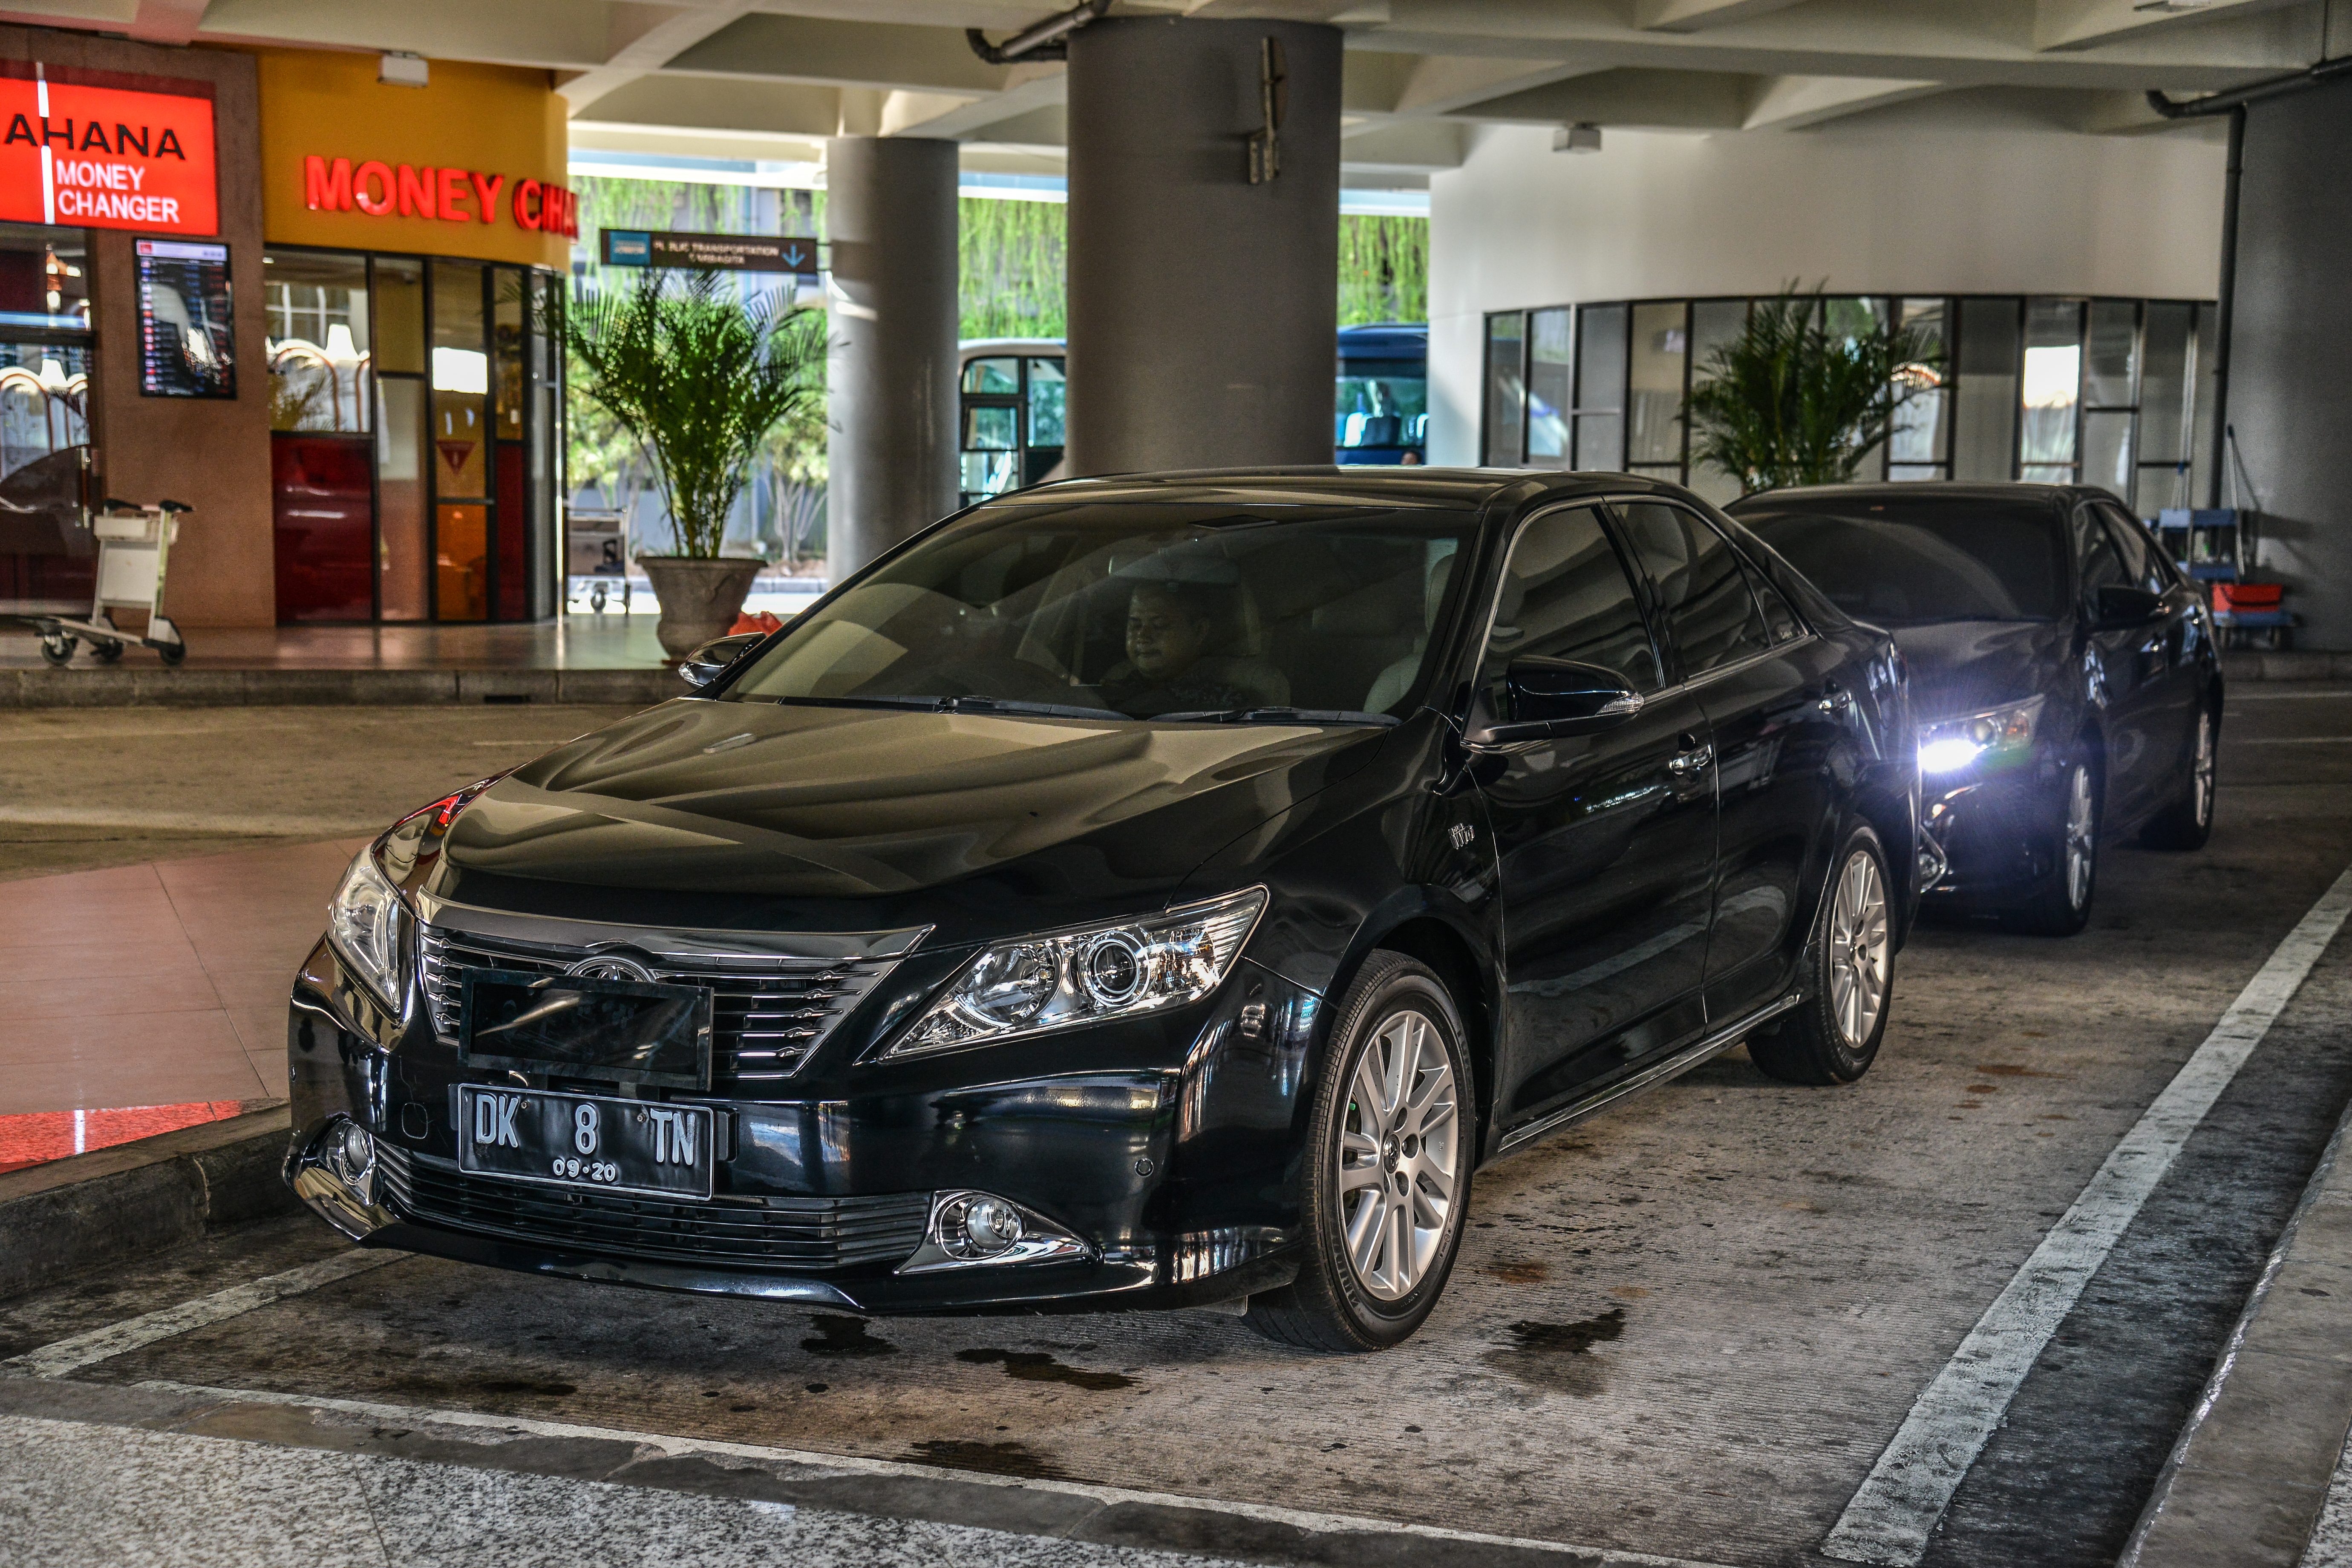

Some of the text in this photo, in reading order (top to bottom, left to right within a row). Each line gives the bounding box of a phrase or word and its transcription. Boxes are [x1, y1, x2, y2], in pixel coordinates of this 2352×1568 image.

[4, 113, 186, 161] AHANA
[56, 159, 145, 191] MONEY
[305, 155, 504, 224] MONEY
[58, 189, 180, 224] CHANGER
[476, 1093, 695, 1165] DK 8 TN
